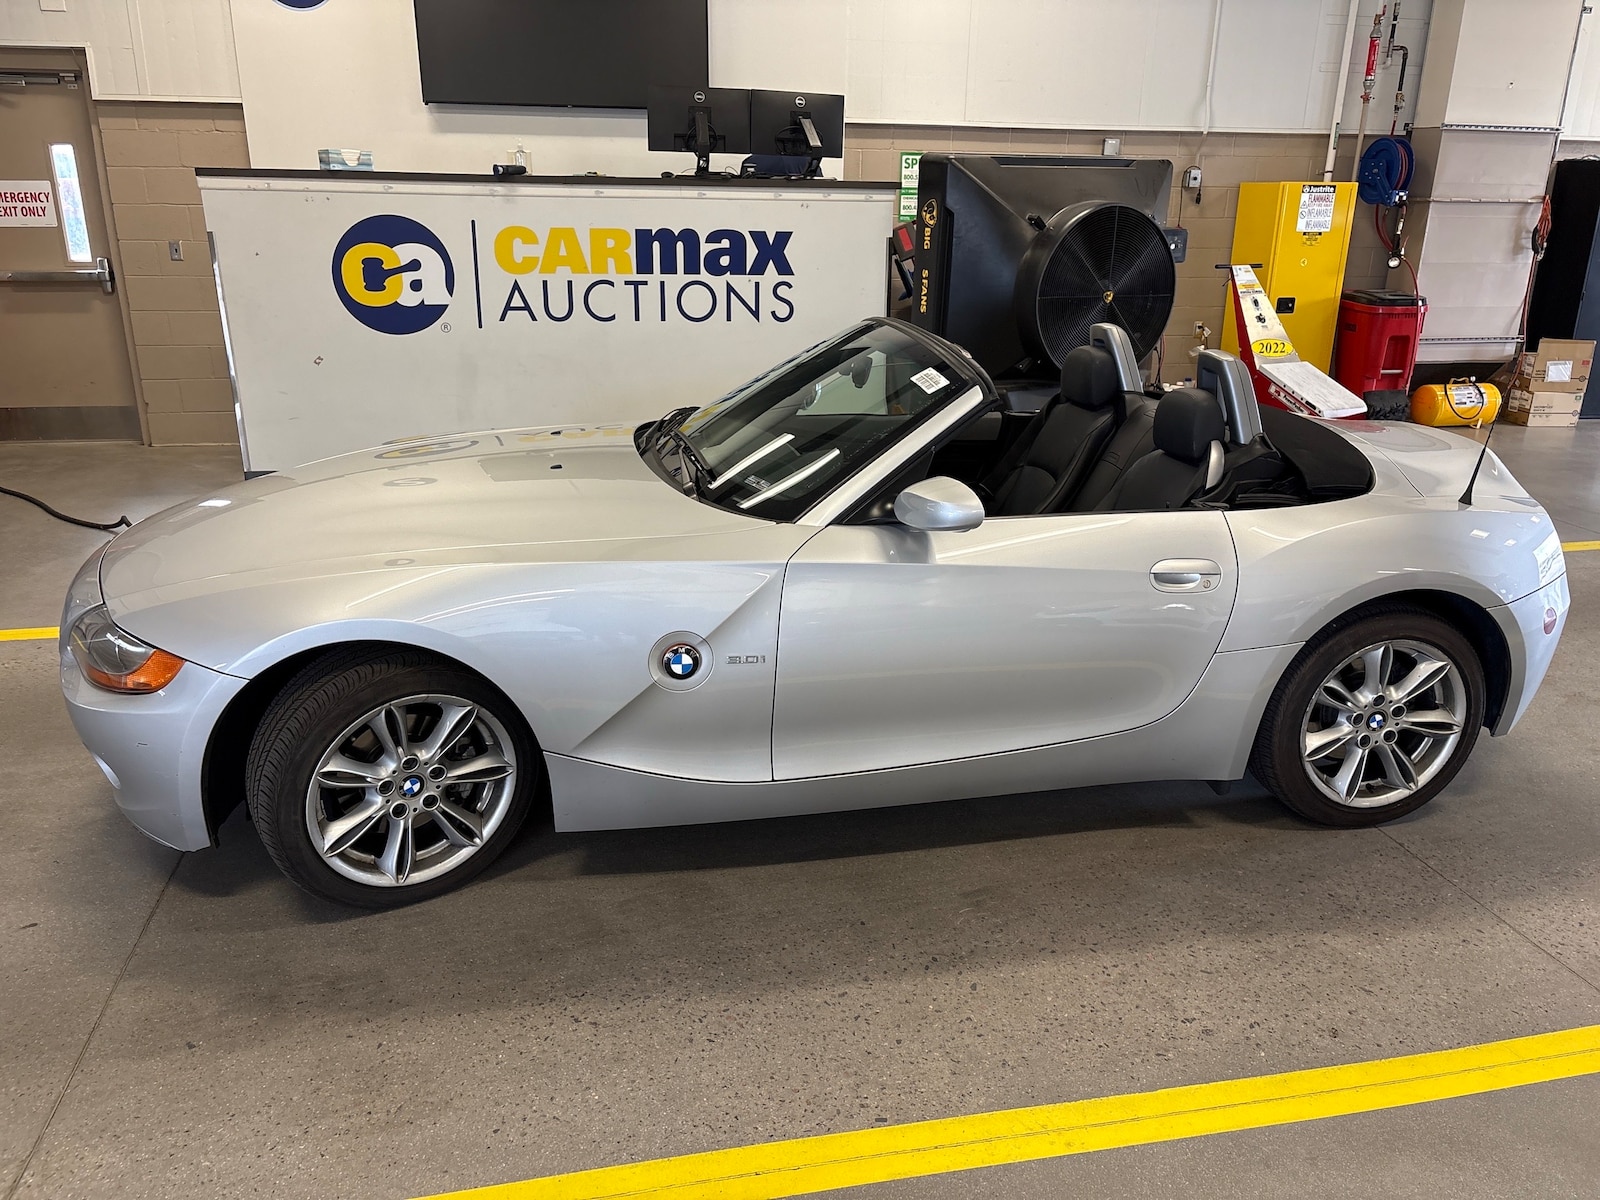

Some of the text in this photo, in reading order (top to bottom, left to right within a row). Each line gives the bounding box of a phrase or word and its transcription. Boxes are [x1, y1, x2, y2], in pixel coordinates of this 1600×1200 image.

[0, 192, 50, 203] ERGENCY
[20, 206, 46, 217] ONLY
[494, 225, 795, 276] CARmax
[923, 228, 931, 250] BIG
[498, 278, 795, 323] AUCTIONS
[920, 280, 928, 313] FANS
